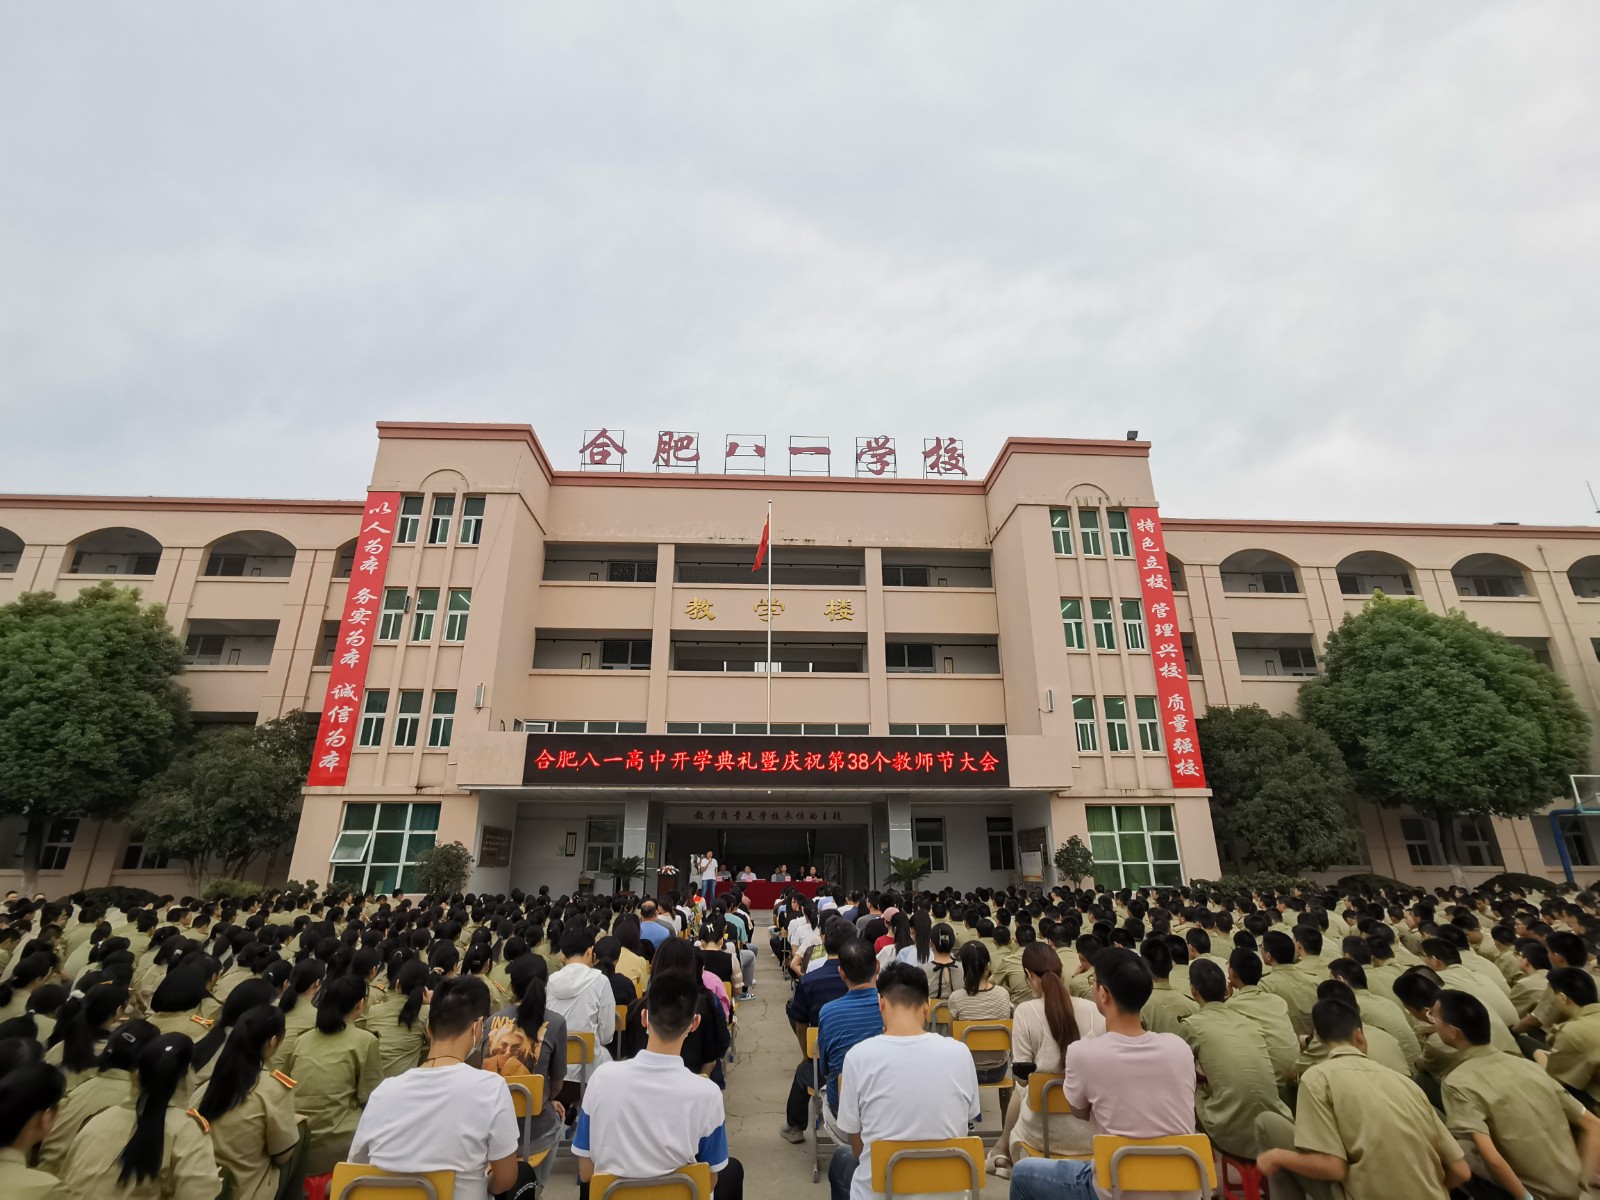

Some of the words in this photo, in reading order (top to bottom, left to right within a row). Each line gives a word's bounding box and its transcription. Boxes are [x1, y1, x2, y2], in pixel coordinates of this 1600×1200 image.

[579, 428, 969, 476] 合肥八一学校
[360, 502, 392, 575] 以人为本
[1136, 518, 1168, 590] 特色立校
[340, 587, 378, 669] 务实为本
[684, 596, 855, 622] 教学楼
[1151, 603, 1183, 680] 管理兴校
[318, 683, 359, 773] 诚信为本
[534, 748, 999, 773] 合肥八一高中开学典礼暨庆祝第38个教师节大会
[1167, 693, 1200, 777] 质量强校
